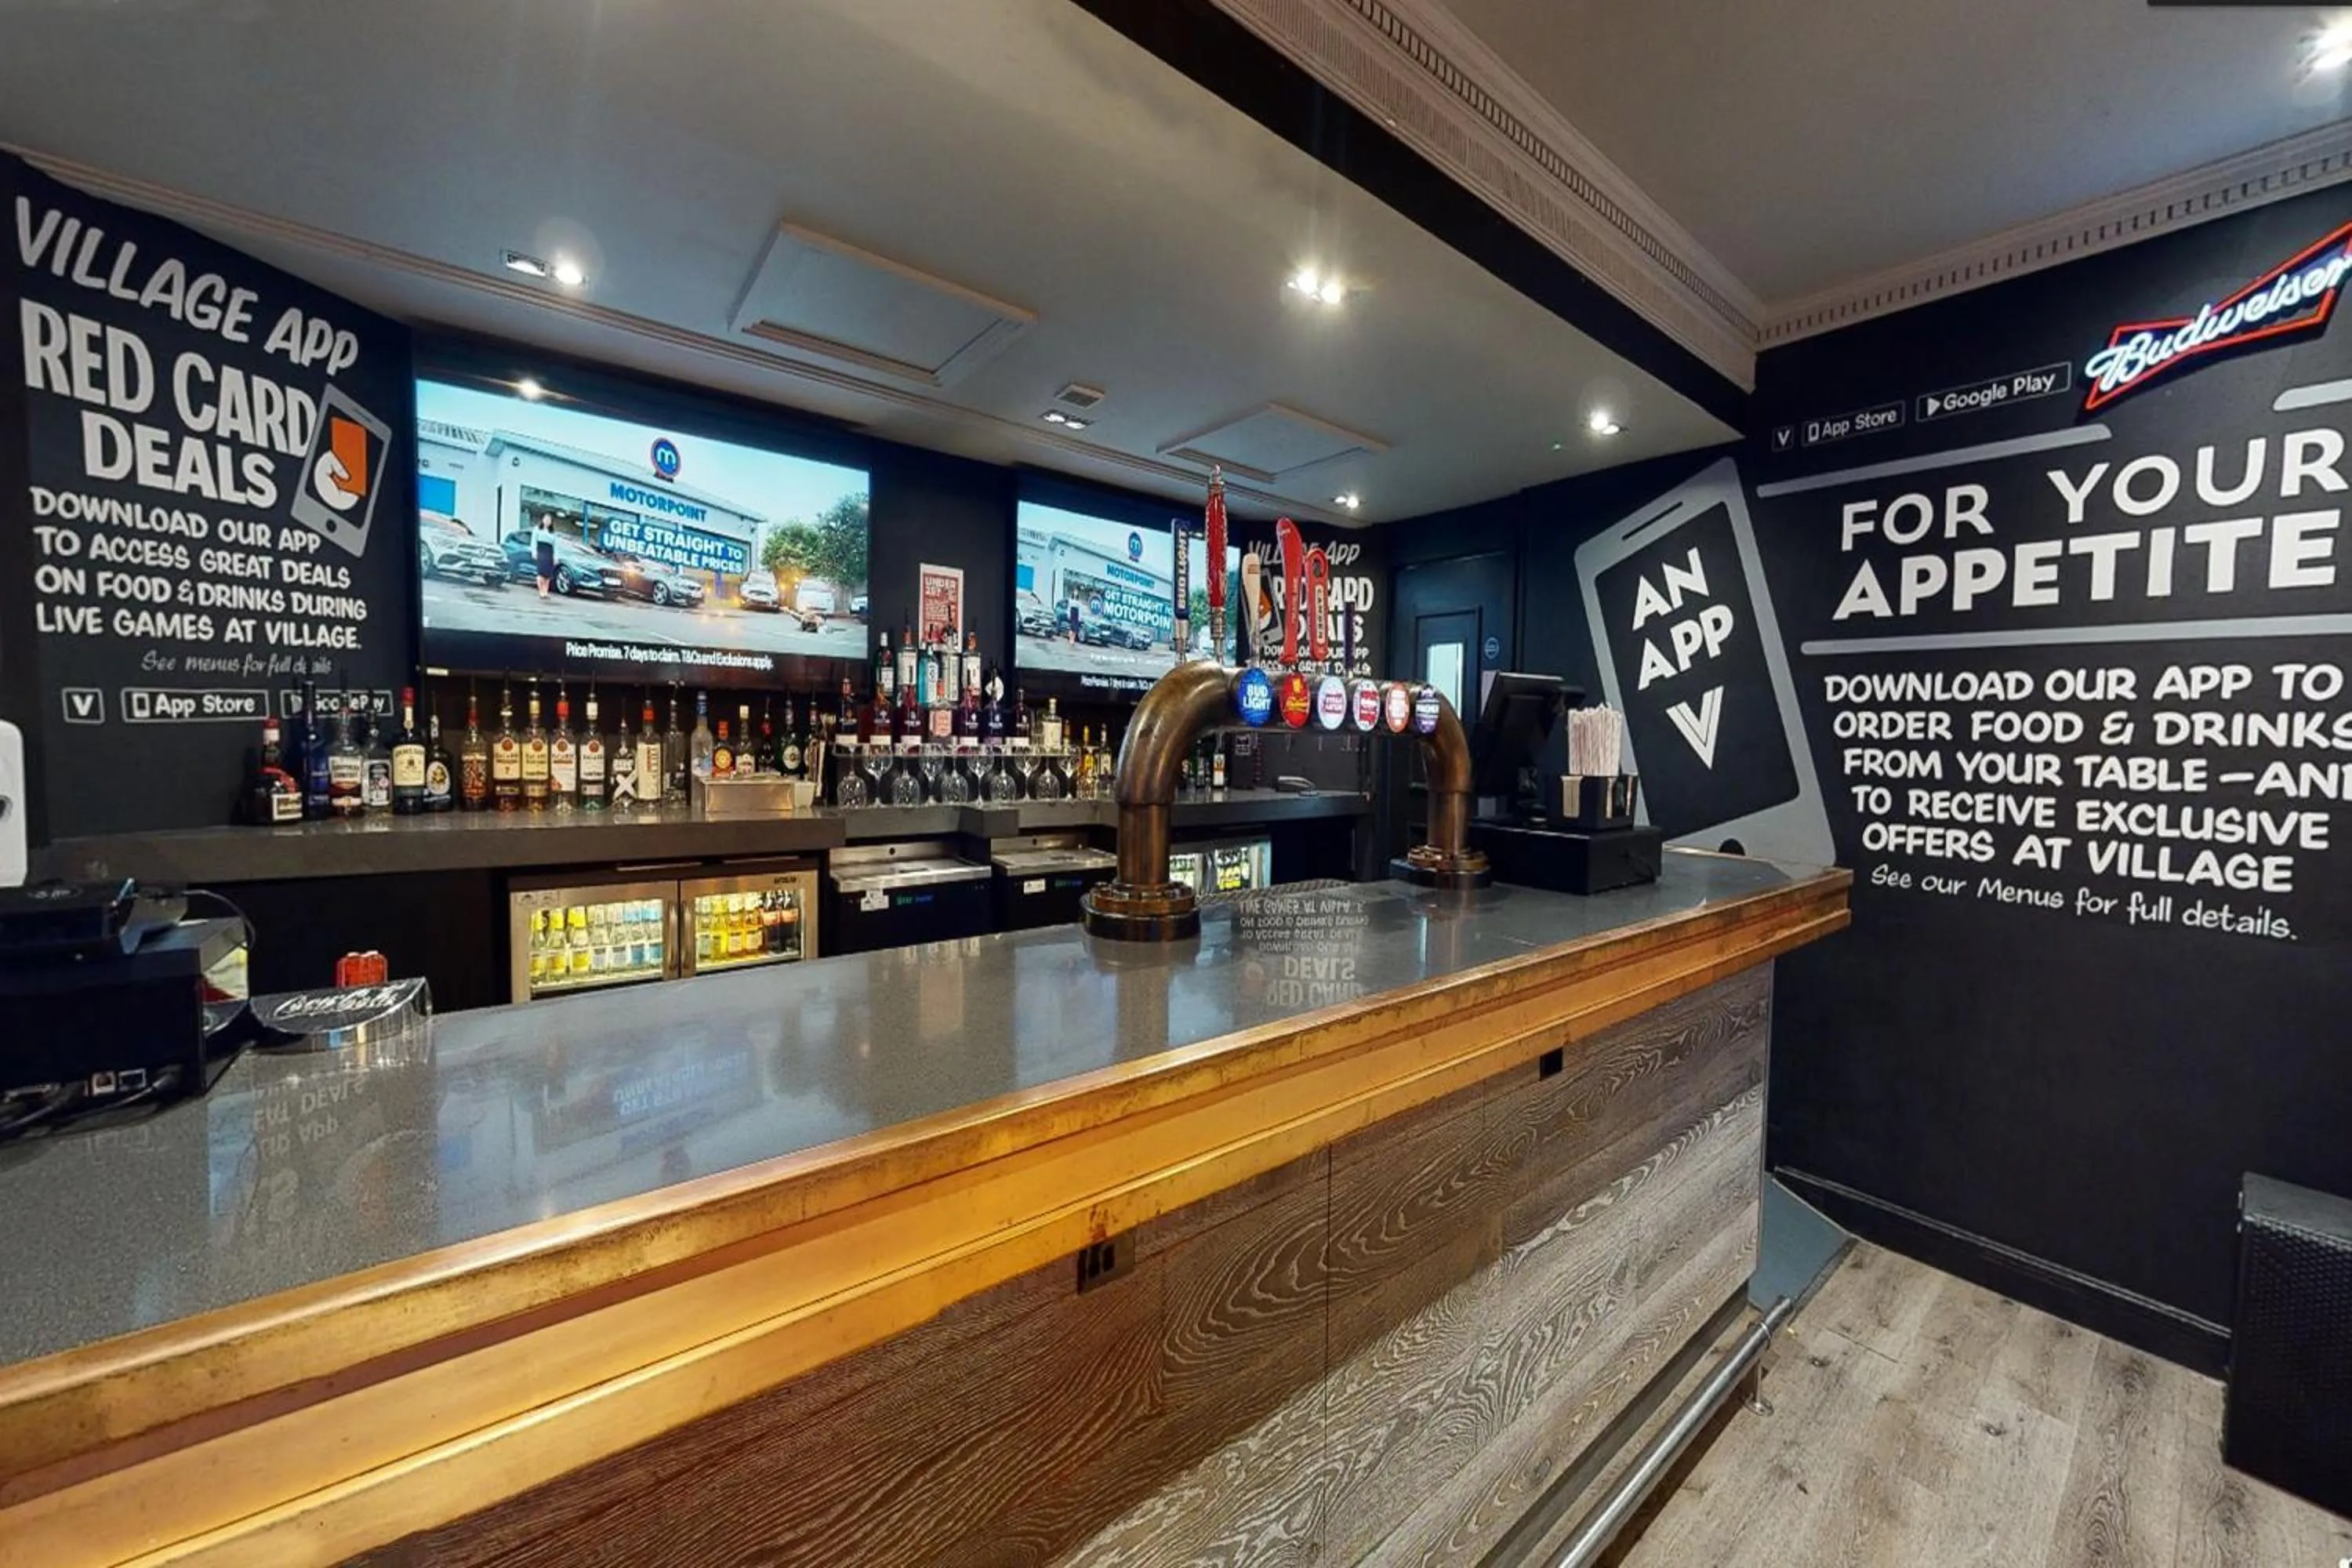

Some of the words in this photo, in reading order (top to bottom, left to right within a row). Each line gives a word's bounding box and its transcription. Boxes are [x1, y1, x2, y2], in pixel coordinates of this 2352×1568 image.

[16, 196, 259, 343] VILLAGE
[264, 308, 358, 376] APP
[2085, 252, 2352, 391] Budweiser
[20, 297, 154, 414] RED
[173, 352, 317, 459] CARD
[1944, 383, 2007, 414] Google
[2013, 371, 2056, 397] Play
[1821, 419, 1849, 439] App
[1855, 408, 1897, 432] Store
[82, 409, 278, 508] DEALS
[610, 482, 707, 523] MOTORPOINT
[1841, 484, 1993, 551] FOR
[2047, 428, 2350, 523] YOUR
[30, 486, 208, 539] DOWNLOAD
[218, 519, 271, 548] OUR
[278, 528, 321, 554] APP
[609, 519, 641, 539] GET
[643, 524, 724, 557] STRAIGHT
[727, 546, 742, 561] TO
[34, 526, 80, 557] TO
[89, 533, 190, 570] ACCESS
[200, 550, 273, 579] GREAT
[281, 560, 350, 588] DEALS
[602, 533, 699, 568] UNBEATABLE
[702, 555, 743, 574] PRICES
[1832, 510, 2341, 621] APPETITE
[34, 565, 85, 596] ON
[96, 571, 172, 602] FOOD
[178, 581, 194, 604] &
[198, 584, 285, 613] DRINKS
[291, 592, 367, 620] DURING
[1632, 547, 1709, 630] AN
[36, 603, 103, 636] LIVE
[113, 611, 214, 641] GAMES
[224, 618, 256, 644] AT
[264, 622, 362, 650] VILLAGE.
[1103, 600, 1171, 629] MOTORPOIN
[141, 651, 175, 671] See
[186, 655, 240, 672] menus
[240, 653, 267, 677] for
[565, 641, 587, 658] Price
[630, 646, 648, 663] days
[1638, 604, 1734, 691] APP
[72, 695, 94, 716] V
[156, 695, 196, 718] App
[203, 695, 256, 713] Store
[1243, 696, 1271, 711] LIGHT
[1247, 685, 1267, 697] BUD
[1824, 671, 2034, 704] DOWNLOAD
[2045, 669, 2137, 701] OUR
[2153, 664, 2253, 701] APP
[2272, 663, 2343, 701] TO
[1666, 685, 1725, 770] V
[1833, 710, 1953, 741] ORDER
[1970, 710, 2083, 744] FOOD
[2100, 710, 2133, 746] &
[2154, 711, 2352, 750] DRINKS
[1843, 748, 1943, 779] FROM
[1956, 750, 2063, 787] YOUR
[2074, 754, 2208, 793] TABLE
[1851, 785, 1893, 816] TO
[1907, 788, 2056, 829] RECEIVE
[2075, 800, 2329, 851] EXCLUSIVE
[1861, 822, 1995, 862] OFFERS
[2013, 835, 2071, 871] AT
[2087, 840, 2293, 893] VILLAGE
[1871, 864, 1912, 890] See
[1921, 873, 1966, 896] our
[1977, 877, 2064, 909] Menus
[2074, 887, 2118, 917] for
[2126, 891, 2172, 926] full
[2182, 901, 2298, 941] details.
